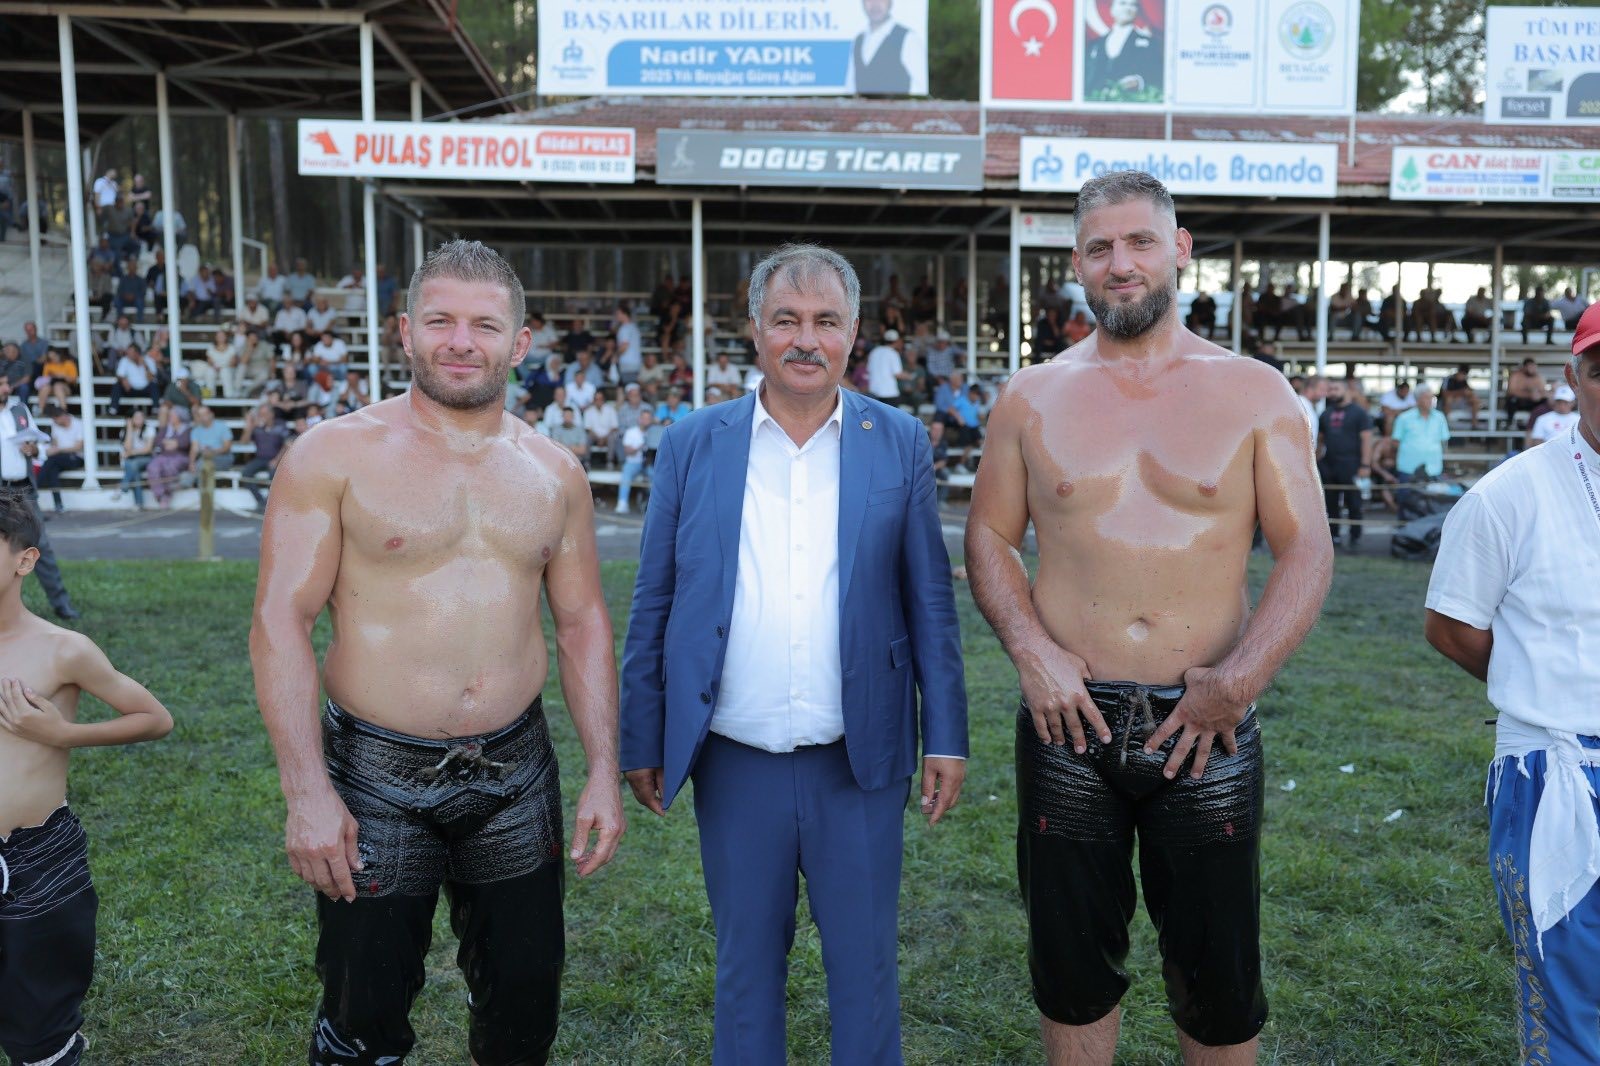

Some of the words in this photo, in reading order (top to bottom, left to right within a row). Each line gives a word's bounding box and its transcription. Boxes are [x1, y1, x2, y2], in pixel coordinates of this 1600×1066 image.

[563, 10, 712, 34] BAŞARILAR
[720, 8, 839, 31] DİLERİM.
[1575, 21, 1600, 35] PE
[640, 46, 718, 64] Nadir
[725, 46, 813, 64] YADIK
[354, 132, 431, 168] PULAŞ
[440, 135, 533, 168] PETROL
[835, 147, 961, 173] TİCARET
[1427, 153, 1481, 169] CAN
[1229, 154, 1324, 183] Branda
